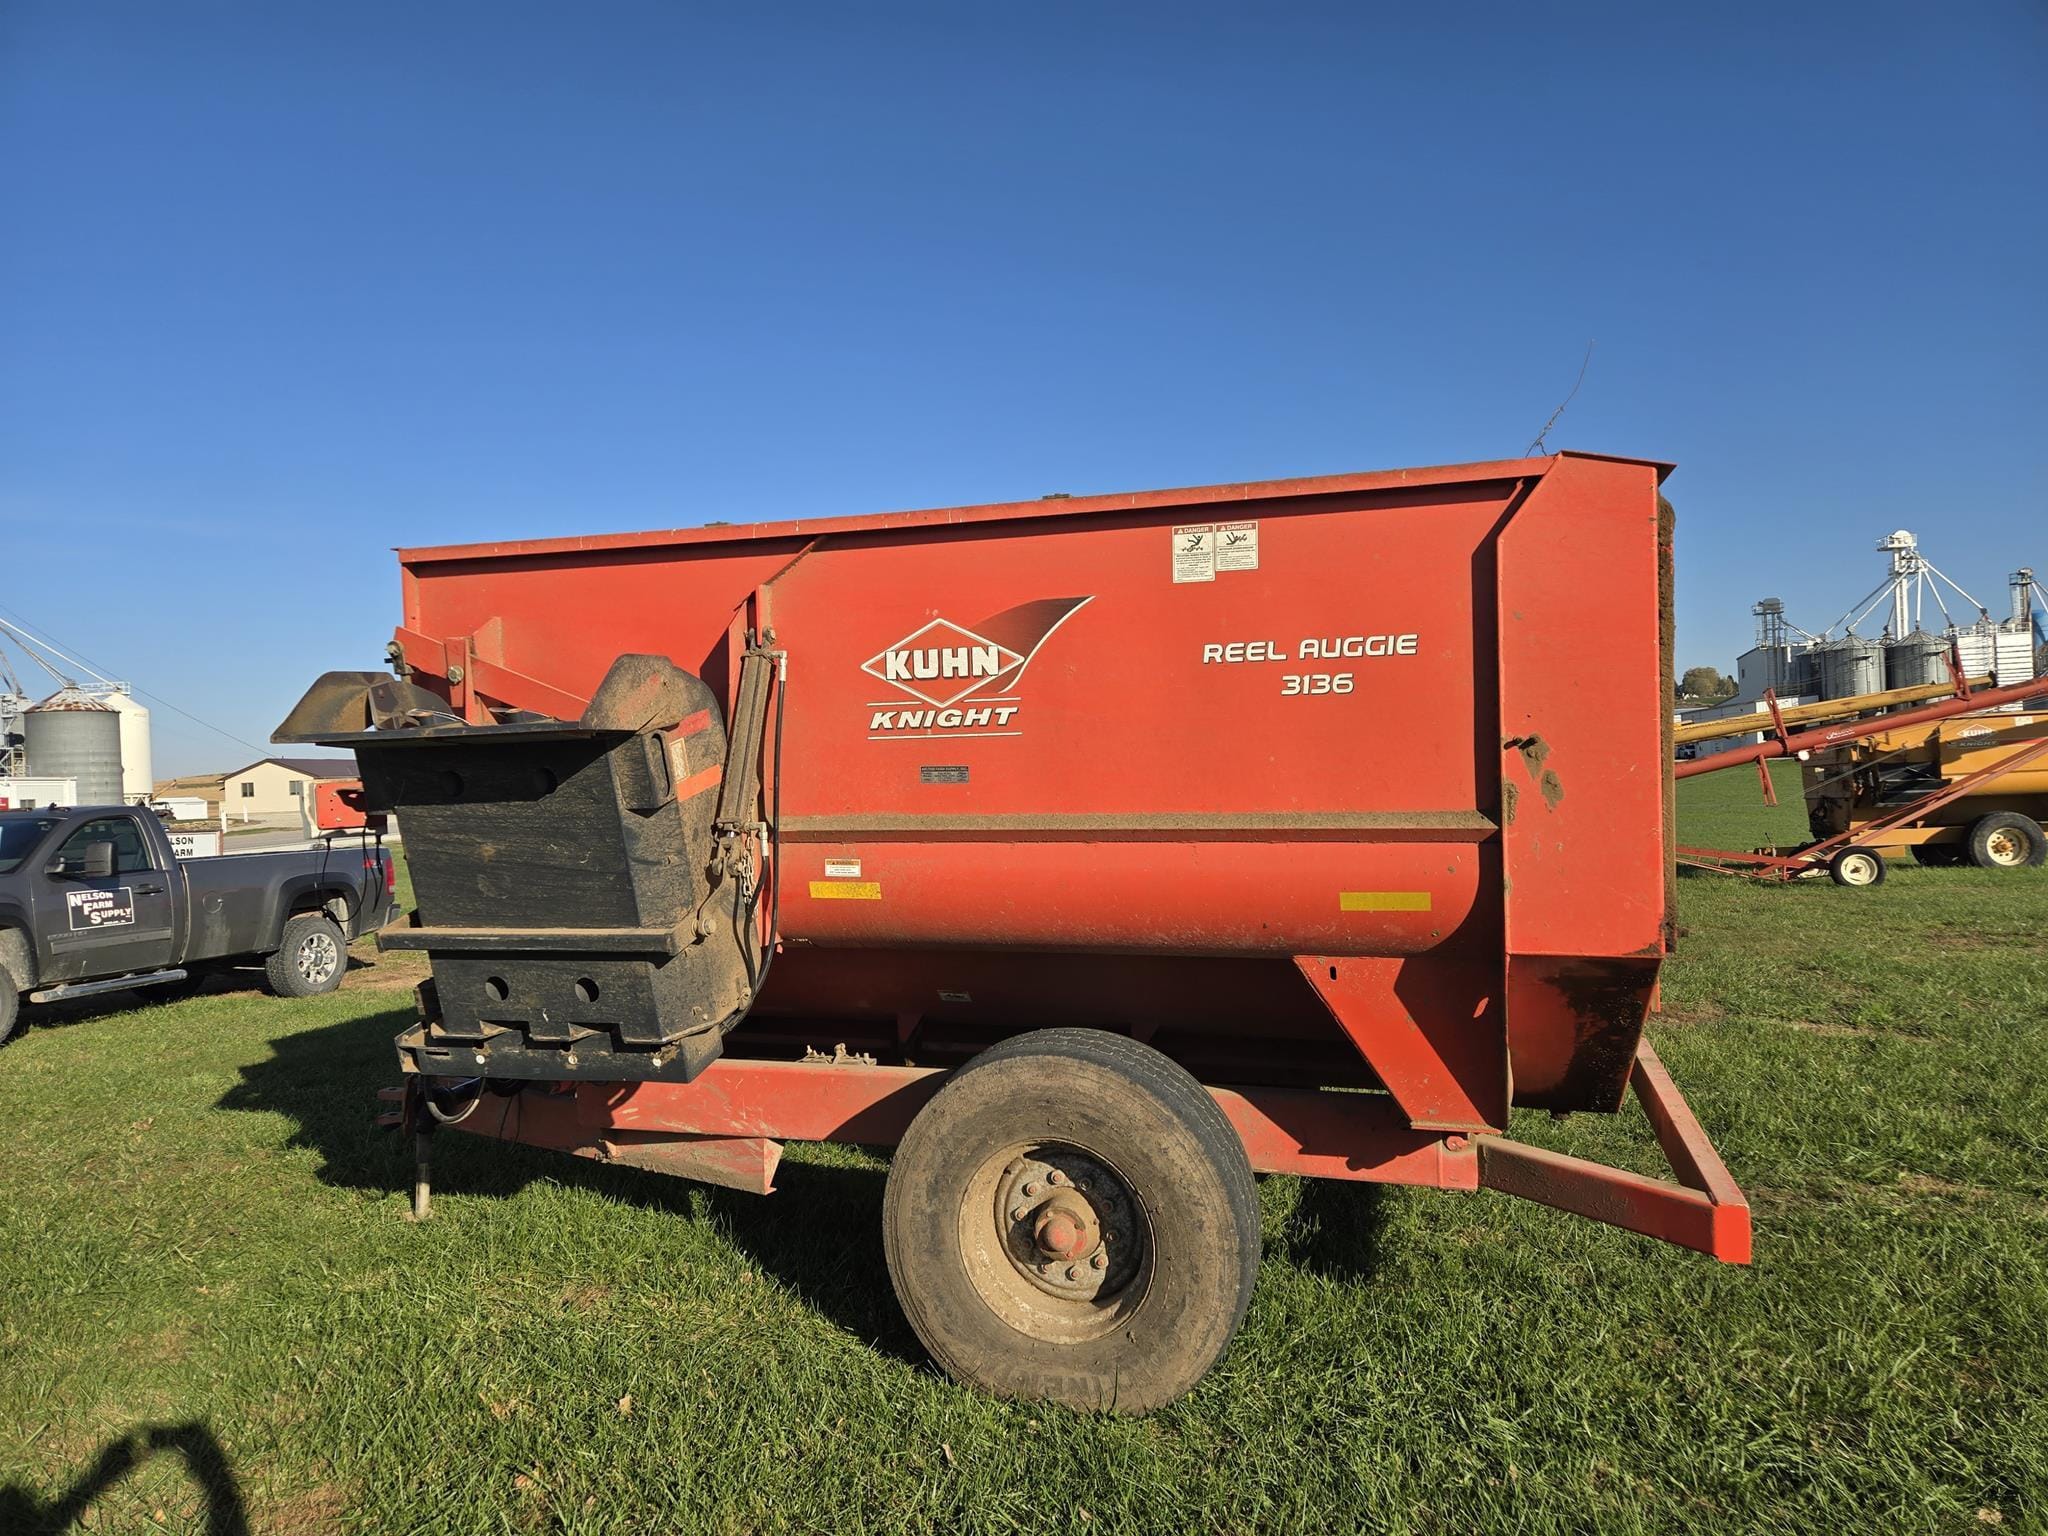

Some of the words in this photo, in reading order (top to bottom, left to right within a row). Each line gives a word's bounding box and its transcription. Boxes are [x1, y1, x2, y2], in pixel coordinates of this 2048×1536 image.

[1183, 526, 1209, 534] DANGER
[1226, 523, 1253, 531] DANGER
[1203, 641, 1287, 664] REEL
[1299, 634, 1419, 659] AUGGIE
[885, 645, 999, 681] KUHN
[1281, 673, 1354, 695] 3136
[869, 707, 1019, 731] KNIGHT
[1960, 740, 1998, 748] KNIGHT
[170, 836, 194, 846] LSON
[174, 848, 194, 857] ARM
[69, 892, 114, 907] NELSON
[83, 900, 114, 916] FARM
[90, 908, 132, 925] SUPPLY
